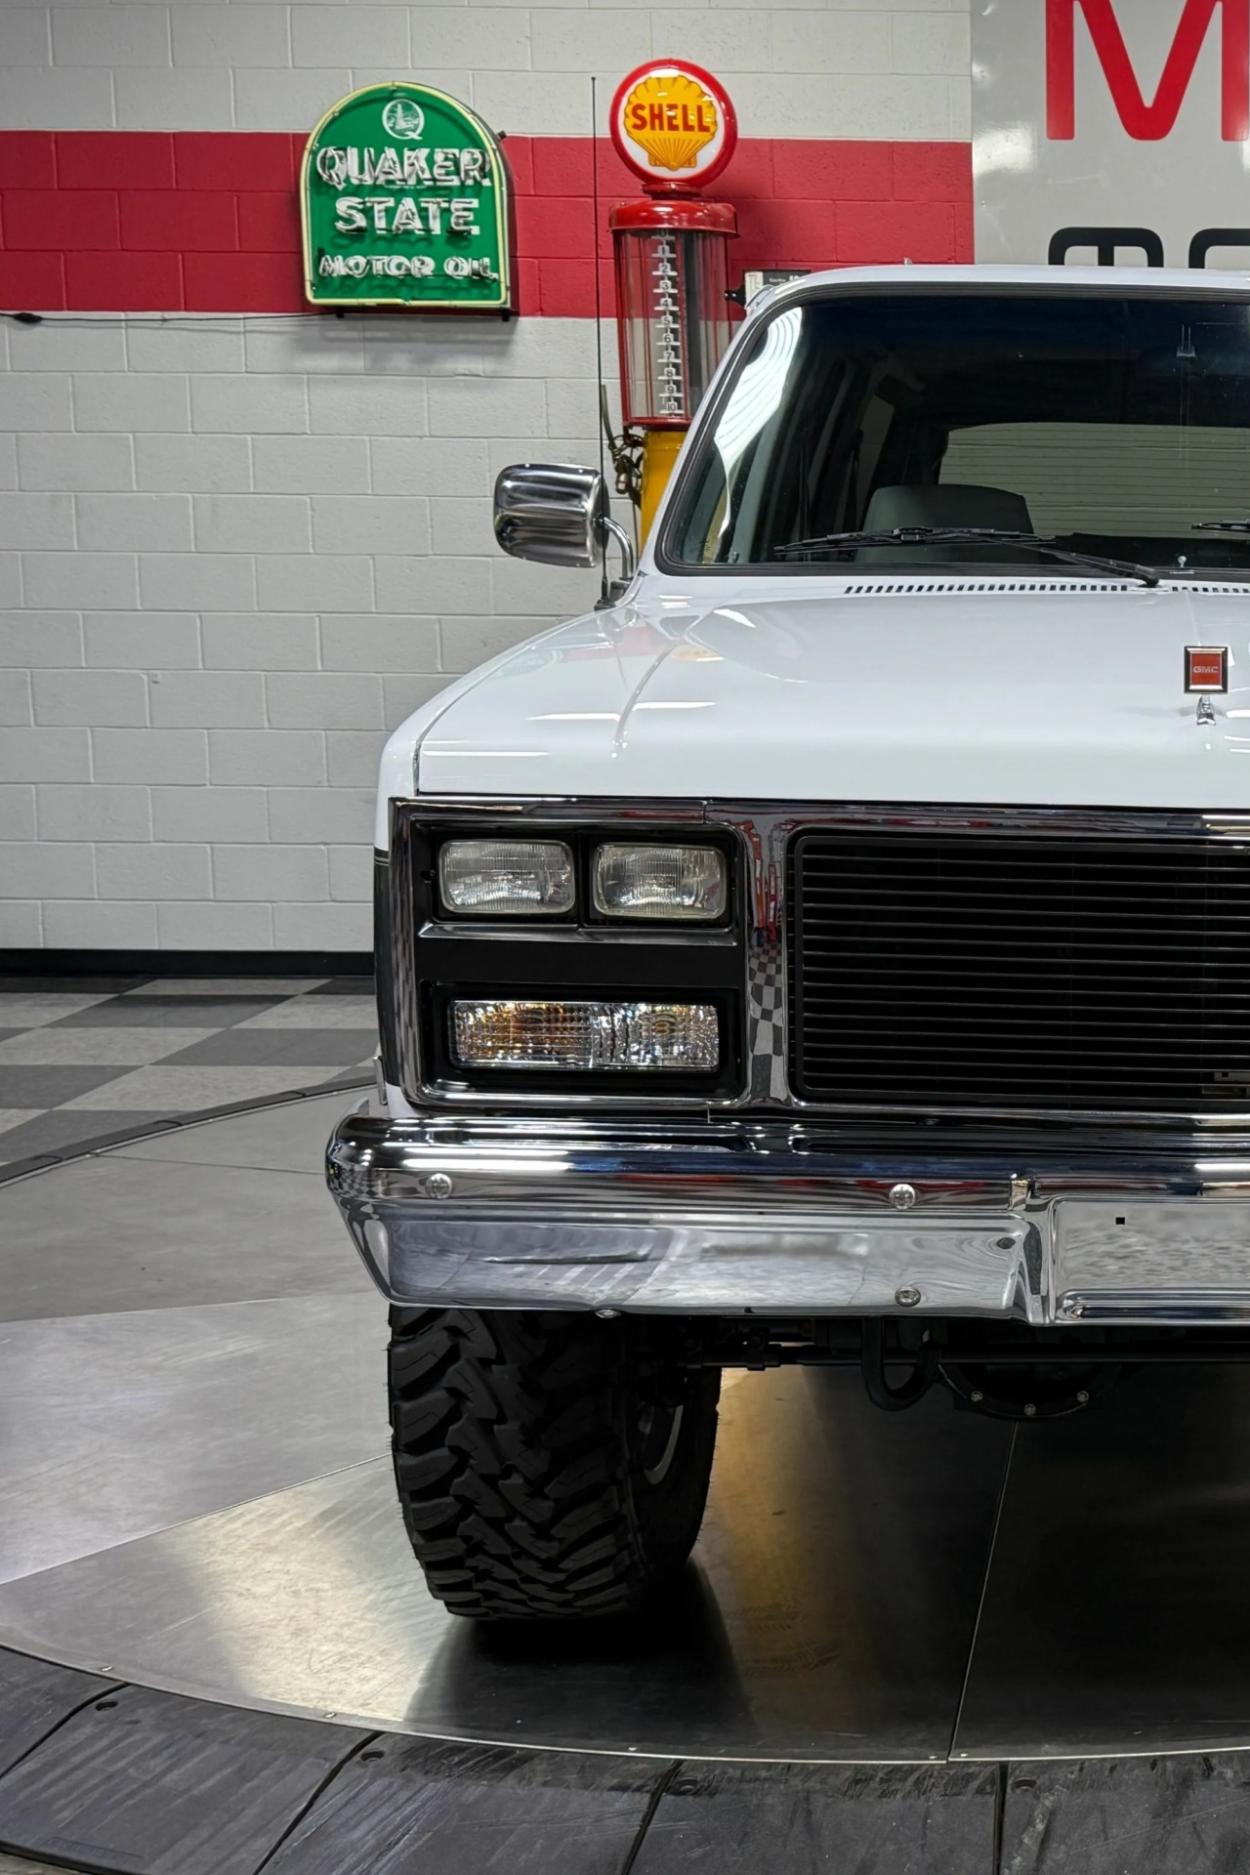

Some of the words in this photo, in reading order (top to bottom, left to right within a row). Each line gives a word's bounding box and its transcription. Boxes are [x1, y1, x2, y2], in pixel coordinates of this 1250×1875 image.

[631, 103, 711, 133] SHELL
[316, 145, 492, 190] QUAKER
[335, 197, 481, 235] STATE
[319, 255, 436, 277] MOTOR
[1193, 665, 1219, 673] GMC
